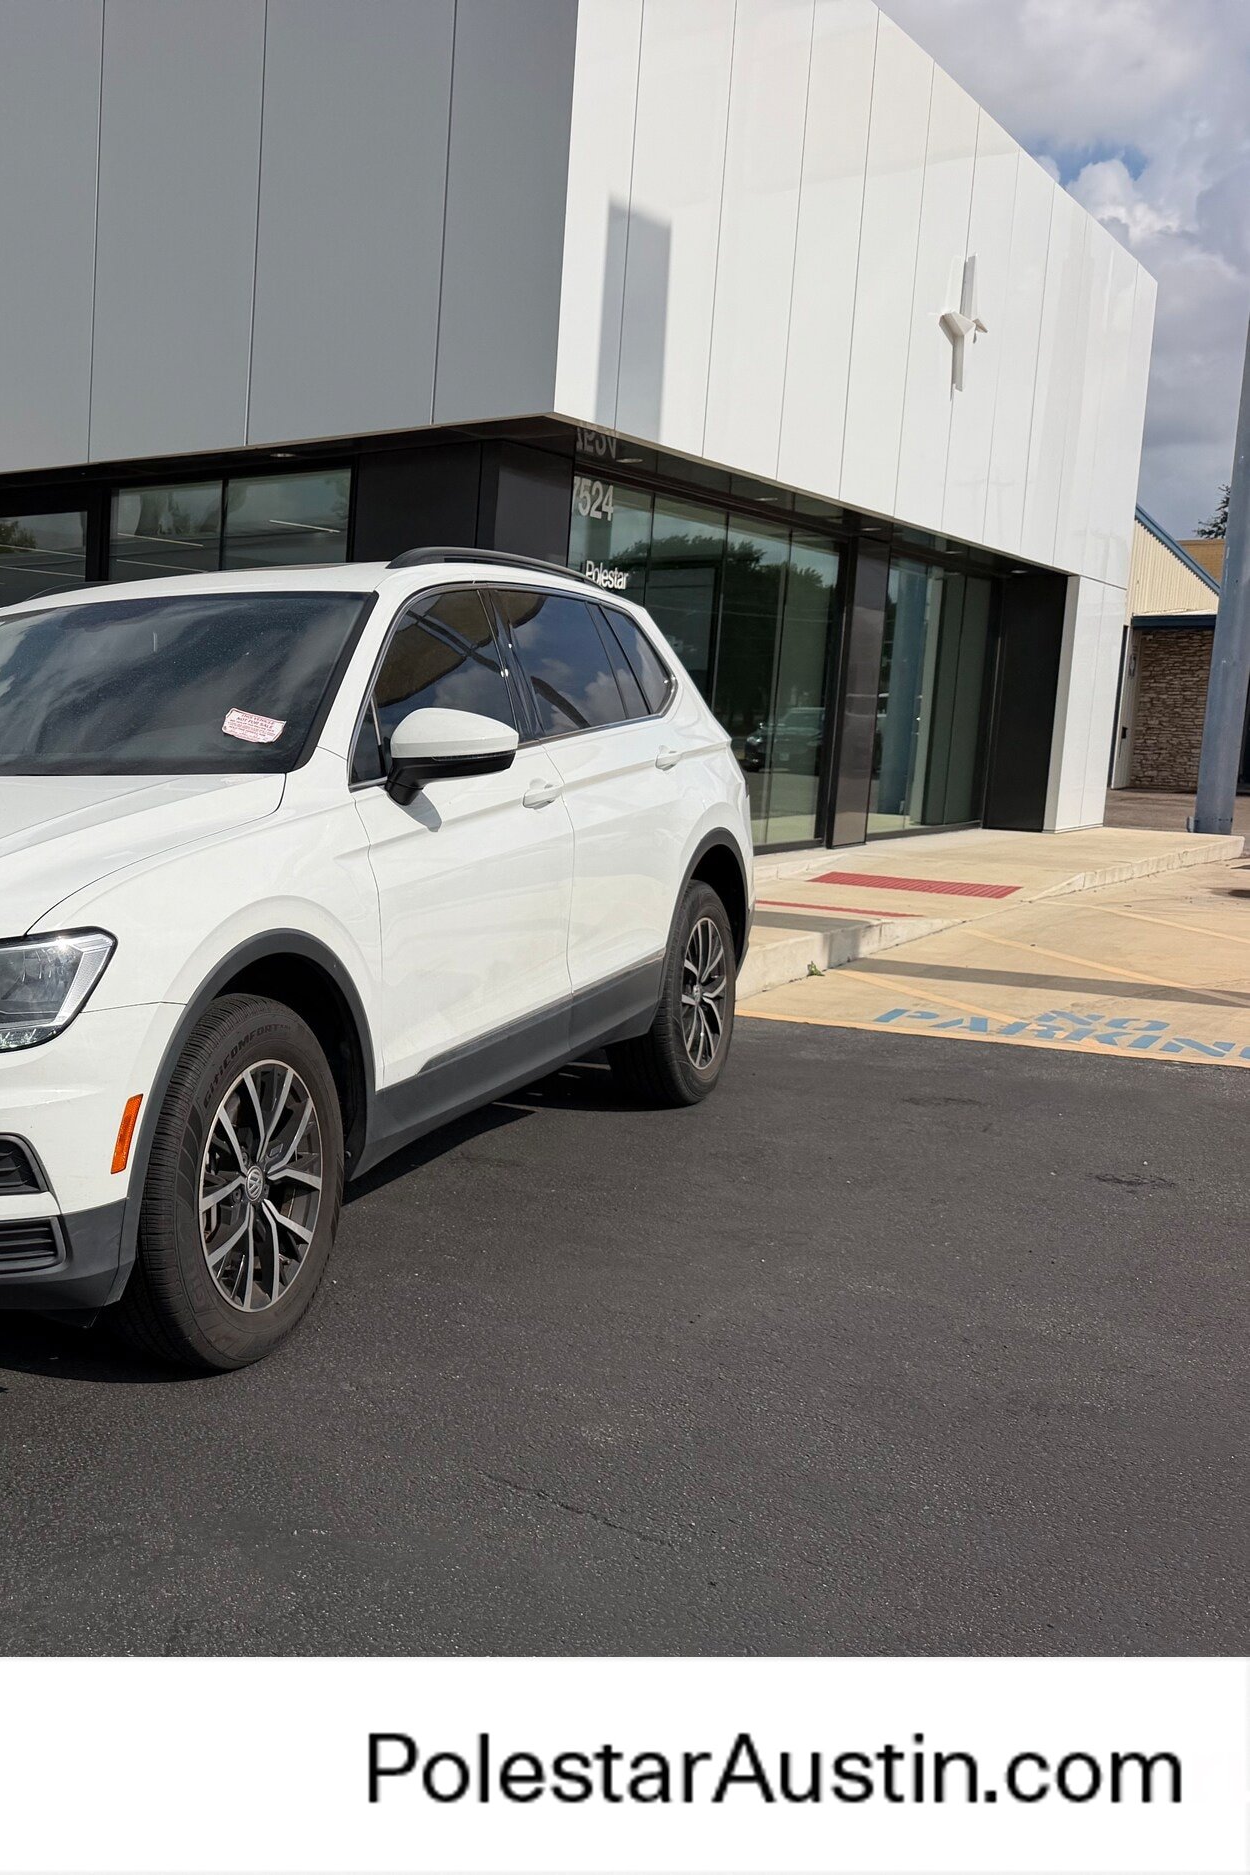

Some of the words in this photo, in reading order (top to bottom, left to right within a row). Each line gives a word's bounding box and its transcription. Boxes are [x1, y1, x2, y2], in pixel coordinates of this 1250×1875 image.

[585, 560, 629, 590] Polestar
[873, 1007, 1250, 1060] PARKIN
[1033, 1008, 1171, 1033] NO
